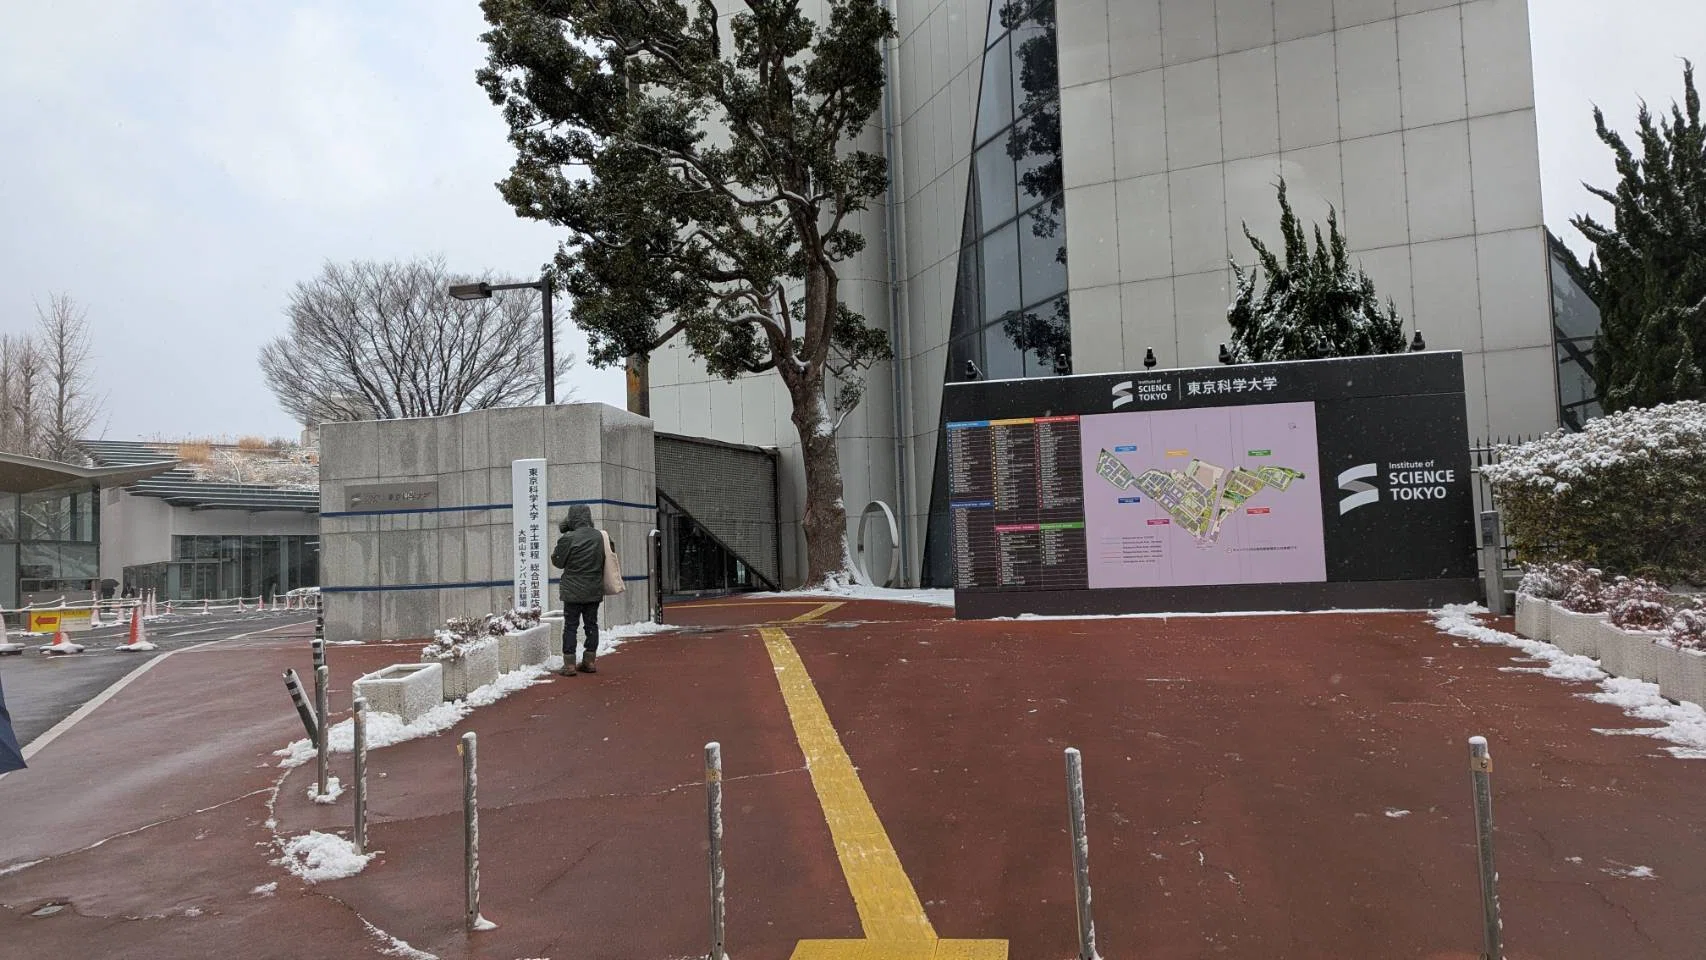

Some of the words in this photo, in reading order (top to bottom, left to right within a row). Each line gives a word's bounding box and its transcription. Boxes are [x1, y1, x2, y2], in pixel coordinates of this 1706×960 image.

[1138, 384, 1171, 393] SCIENCE
[1187, 376, 1277, 396] 東京科学大学
[1138, 392, 1168, 401] TOKYO
[1388, 461, 1423, 469] Institute
[1425, 460, 1435, 468] of
[1389, 469, 1455, 485] SCIENCE
[528, 468, 540, 521] 東京科学大学
[1390, 486, 1447, 501] TOKYO
[530, 524, 541, 559] 学士課程
